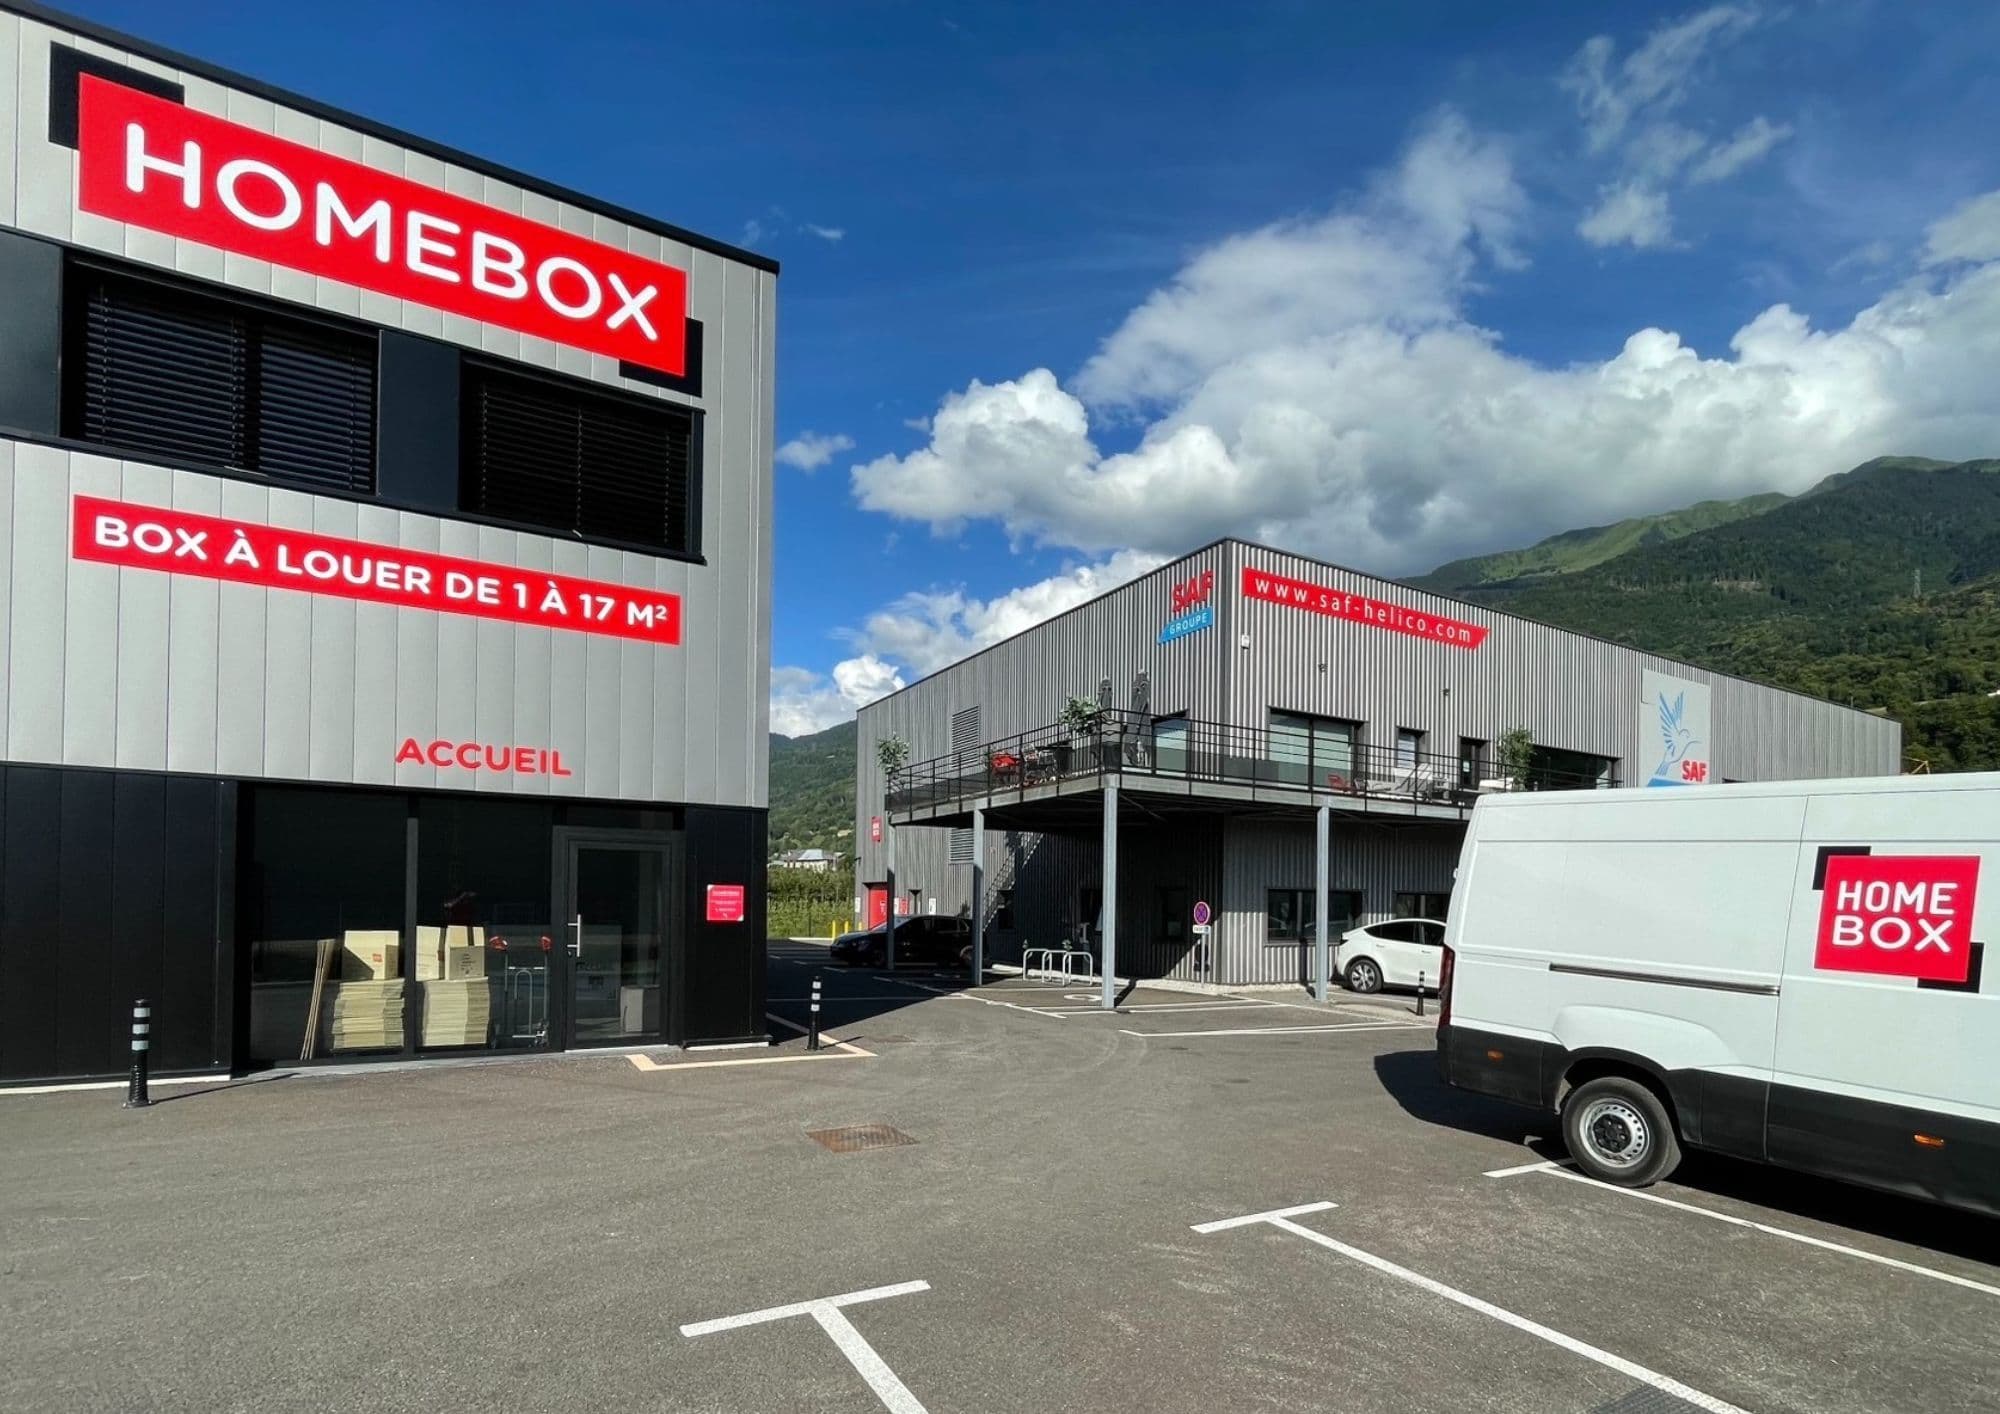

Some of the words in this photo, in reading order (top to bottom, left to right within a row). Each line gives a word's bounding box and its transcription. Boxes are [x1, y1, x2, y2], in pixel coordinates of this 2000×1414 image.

[125, 122, 659, 342] HOMEBOX
[95, 515, 207, 561] BOX
[224, 529, 260, 569] À
[277, 544, 431, 595] LOUER
[445, 572, 501, 605] DE
[513, 582, 527, 609] 1
[540, 580, 568, 615] À
[579, 593, 616, 621] 17
[1173, 571, 1213, 613] SAF
[1254, 577, 1472, 643] www.saf-helico.com
[1169, 612, 1209, 635] GROUPE
[395, 737, 571, 777] ACCUEIL
[1682, 760, 1707, 782] SAF
[1836, 880, 1958, 916] HOME
[1832, 914, 1953, 953] BOX
